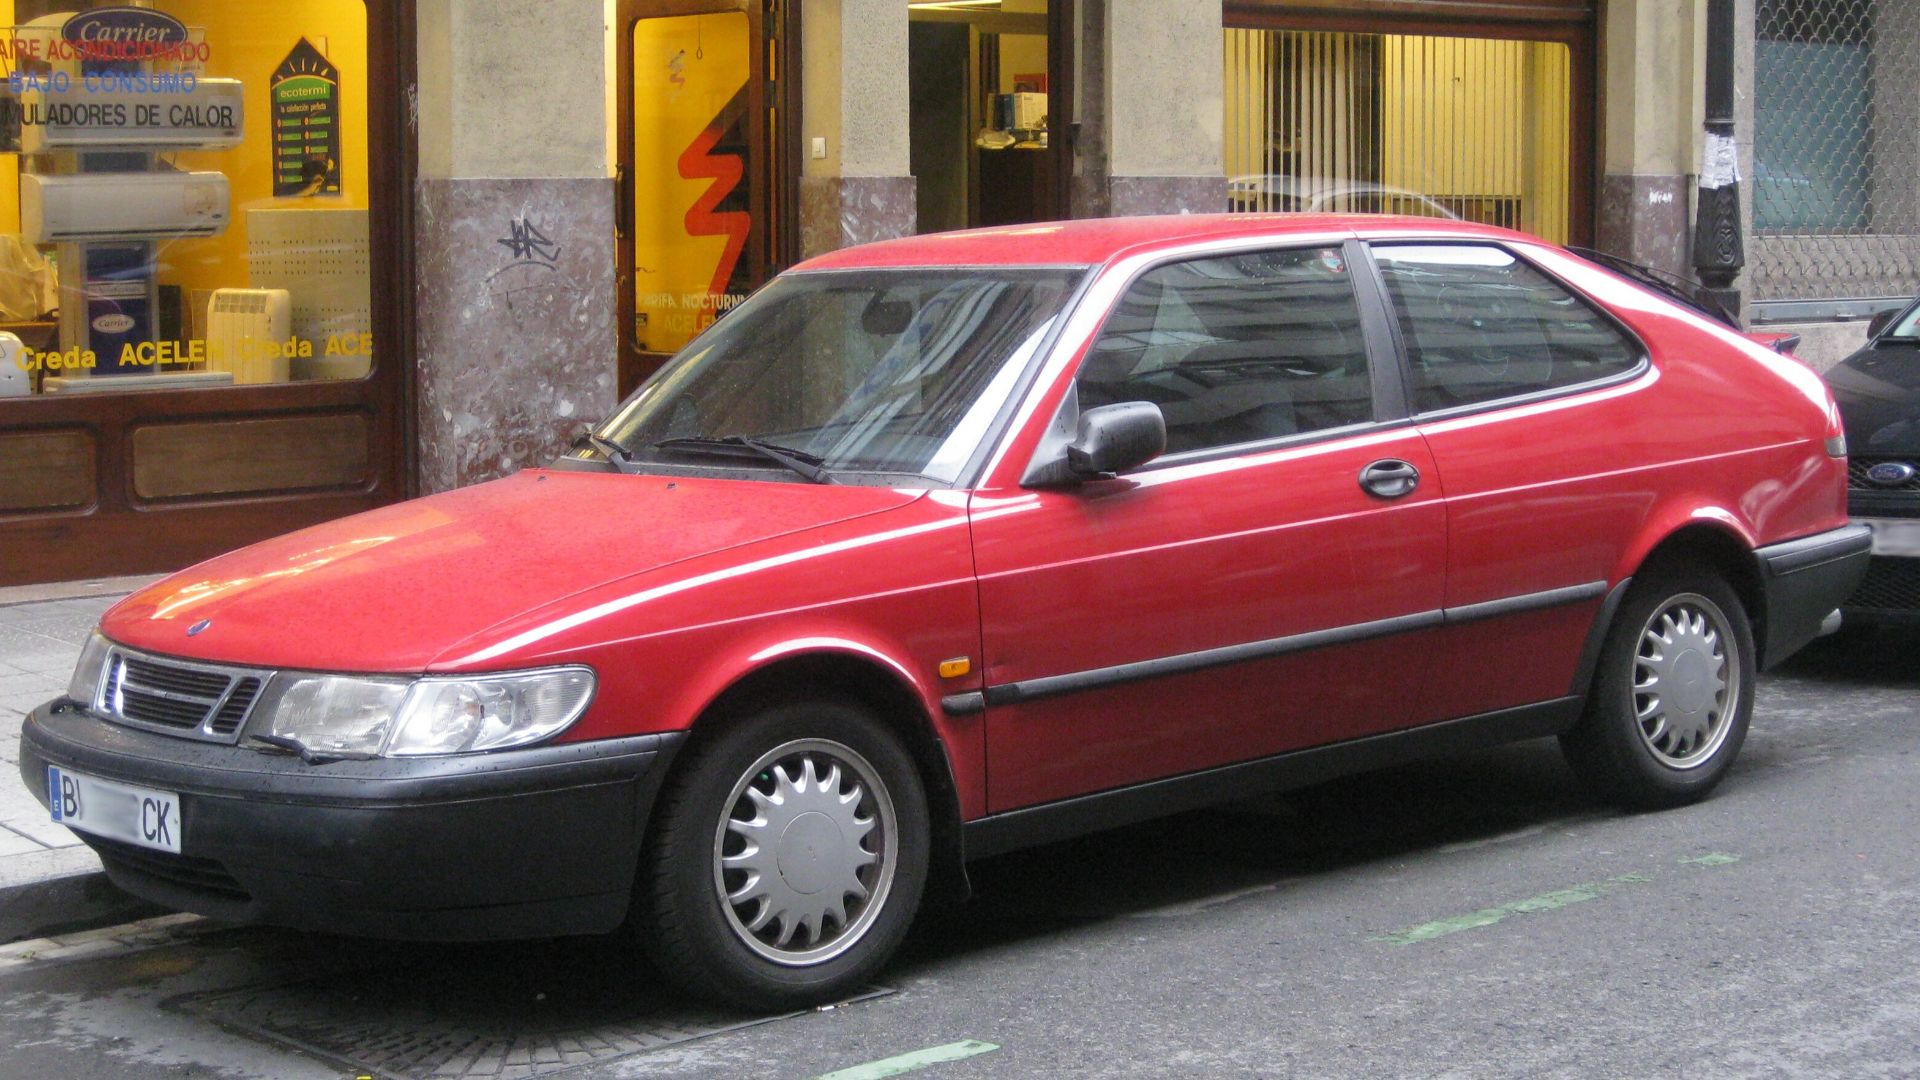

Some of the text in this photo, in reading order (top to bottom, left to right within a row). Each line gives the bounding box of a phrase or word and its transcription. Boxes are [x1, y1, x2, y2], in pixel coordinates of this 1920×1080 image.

[80, 20, 171, 43] Carrier
[0, 39, 210, 62] AIRE ACONDICIONADO
[10, 70, 196, 94] BAJO CONSUMO
[280, 83, 327, 98] ecotermi
[135, 104, 160, 126] DE
[169, 104, 233, 129] CALOR
[98, 317, 130, 327] Carrier
[15, 345, 97, 371] Creda
[142, 797, 171, 846] CK
